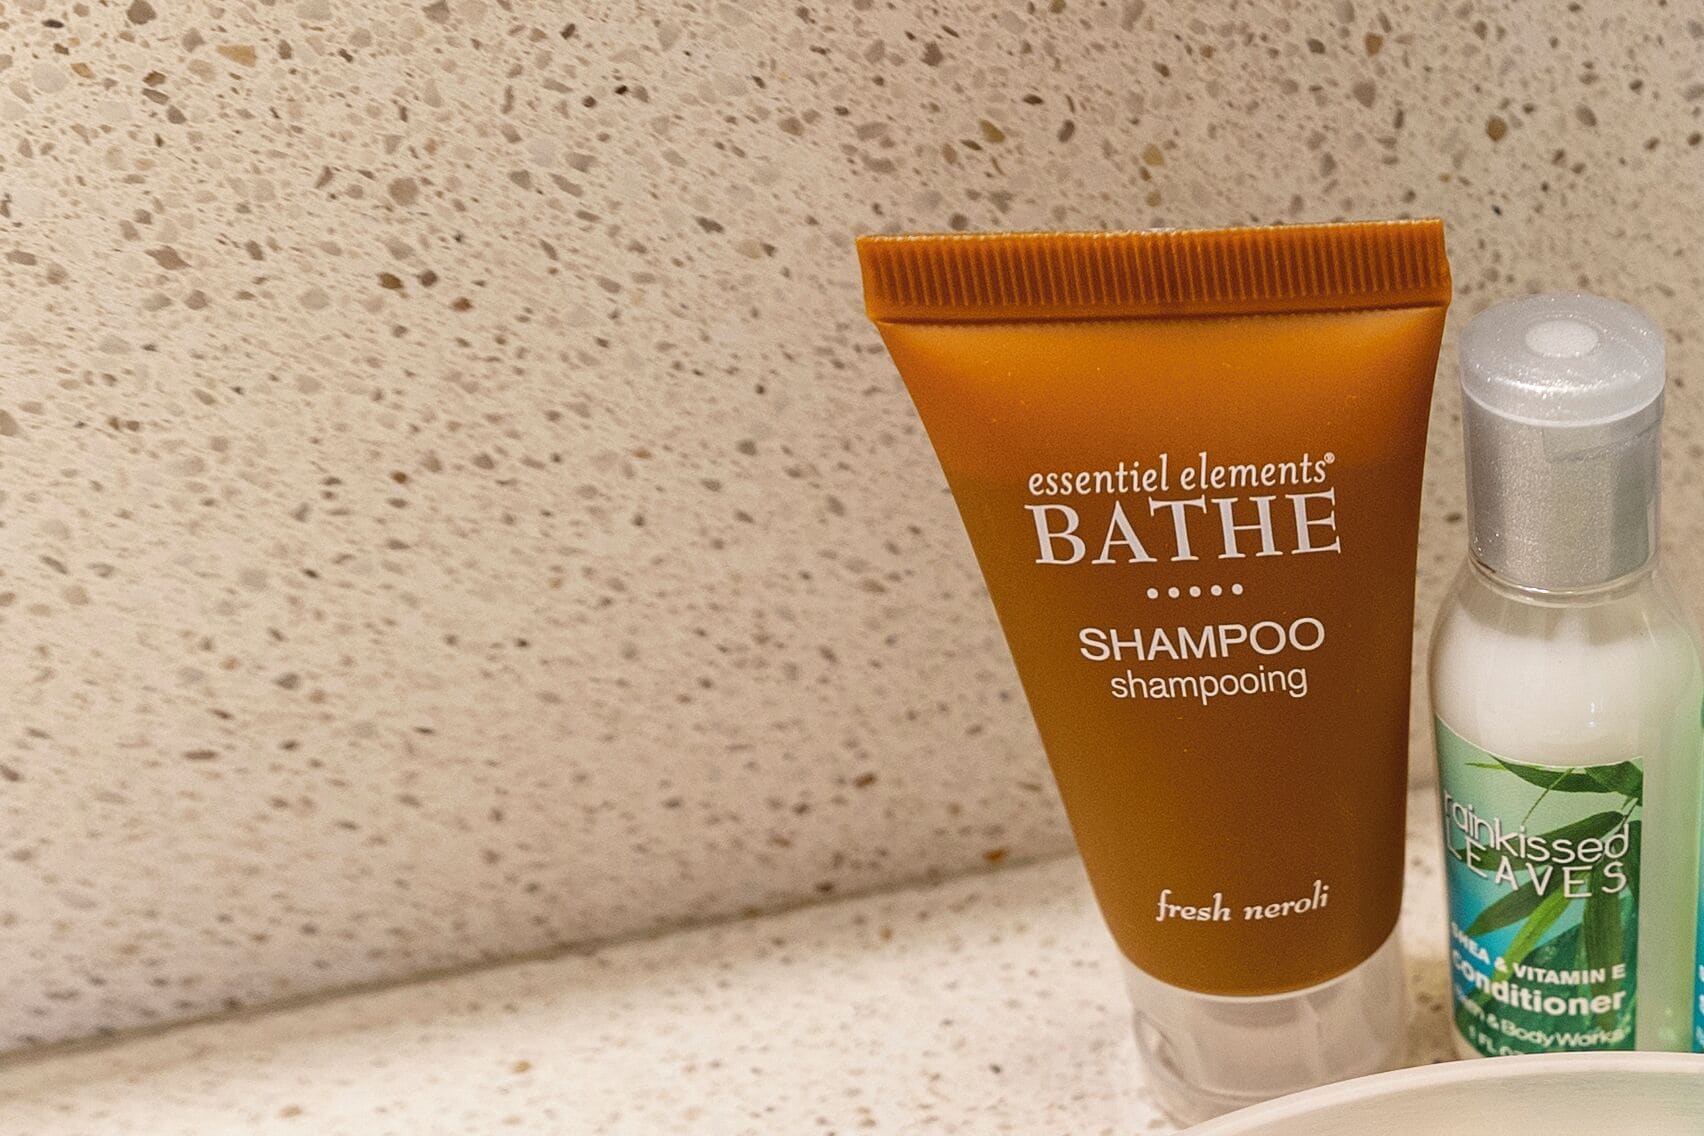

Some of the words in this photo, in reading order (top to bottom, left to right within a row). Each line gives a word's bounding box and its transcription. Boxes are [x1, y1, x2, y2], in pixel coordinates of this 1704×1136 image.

[1028, 453, 1169, 496] essentiel
[1024, 486, 1342, 565] BATHE
[1079, 617, 1325, 661] SHAMPOO
[1111, 665, 1308, 705] shampooing
[1444, 789, 1630, 864] rainkissed
[1446, 816, 1628, 898] LEAVES
[1156, 889, 1232, 922] fresh
[1243, 879, 1329, 920] neroli
[1453, 948, 1627, 1016] conditioner
[1512, 962, 1606, 985] VITAMIN
[1611, 963, 1627, 979] E
